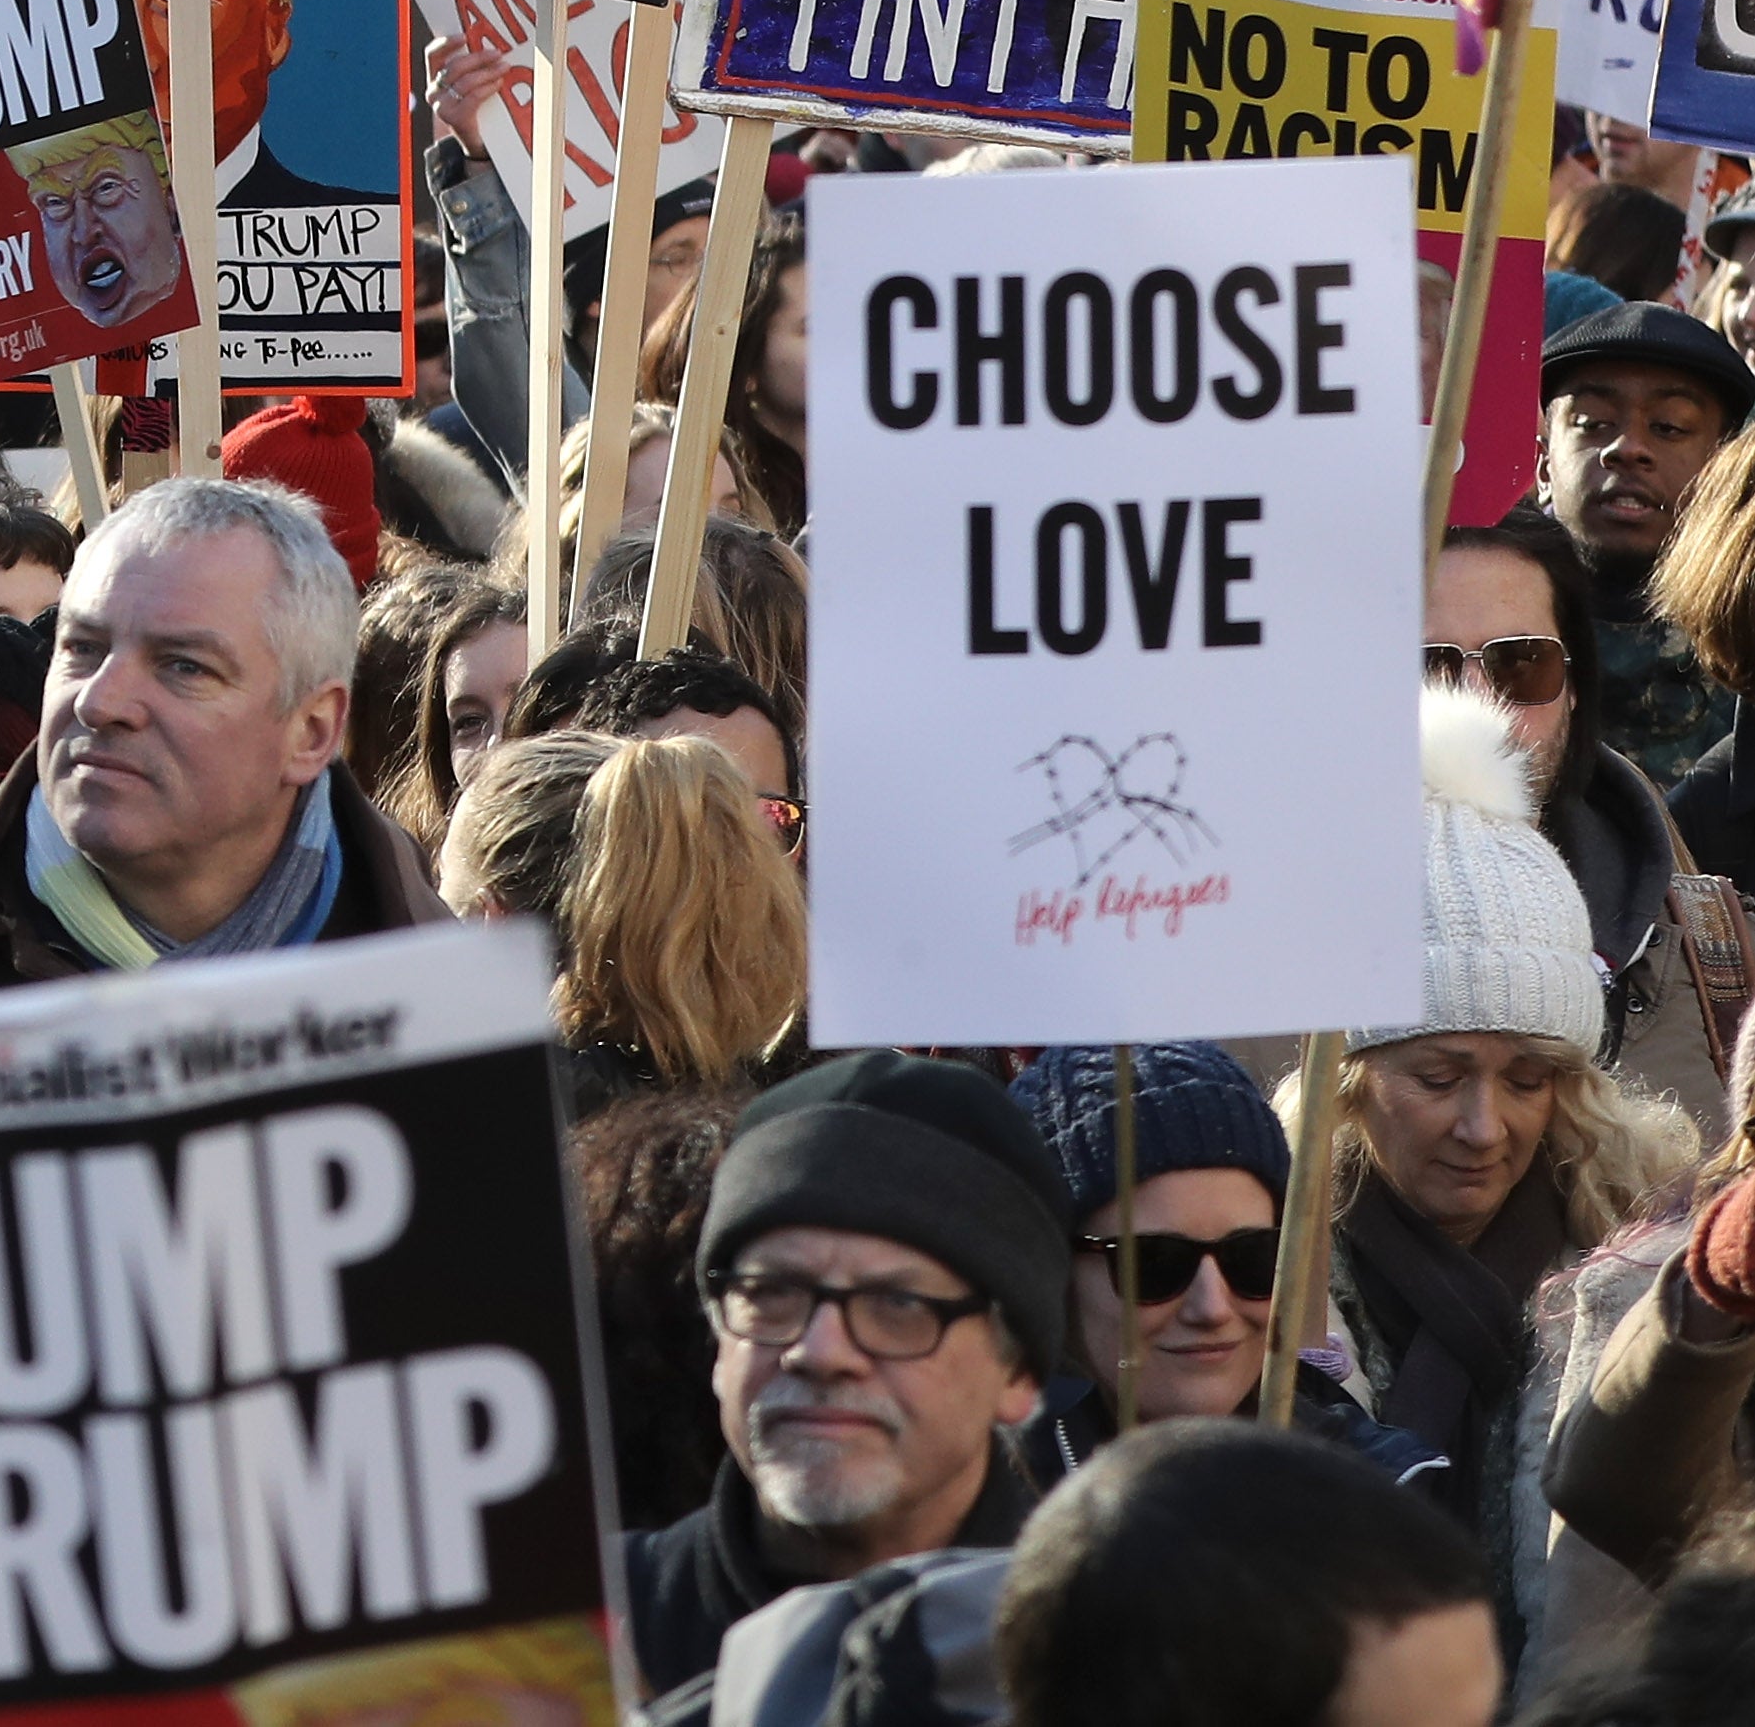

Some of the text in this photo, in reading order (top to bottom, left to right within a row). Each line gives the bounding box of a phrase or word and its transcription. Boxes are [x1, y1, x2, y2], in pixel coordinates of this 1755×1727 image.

[1168, 1, 1287, 100] NO
[1312, 27, 1431, 121] TO
[218, 207, 380, 258] TRUMP
[292, 265, 385, 315] PAY!
[865, 261, 1357, 430] CHOOSE
[964, 495, 1264, 658] LOVE
[1015, 885, 1082, 947] Help
[169, 1001, 405, 1088] Worker
